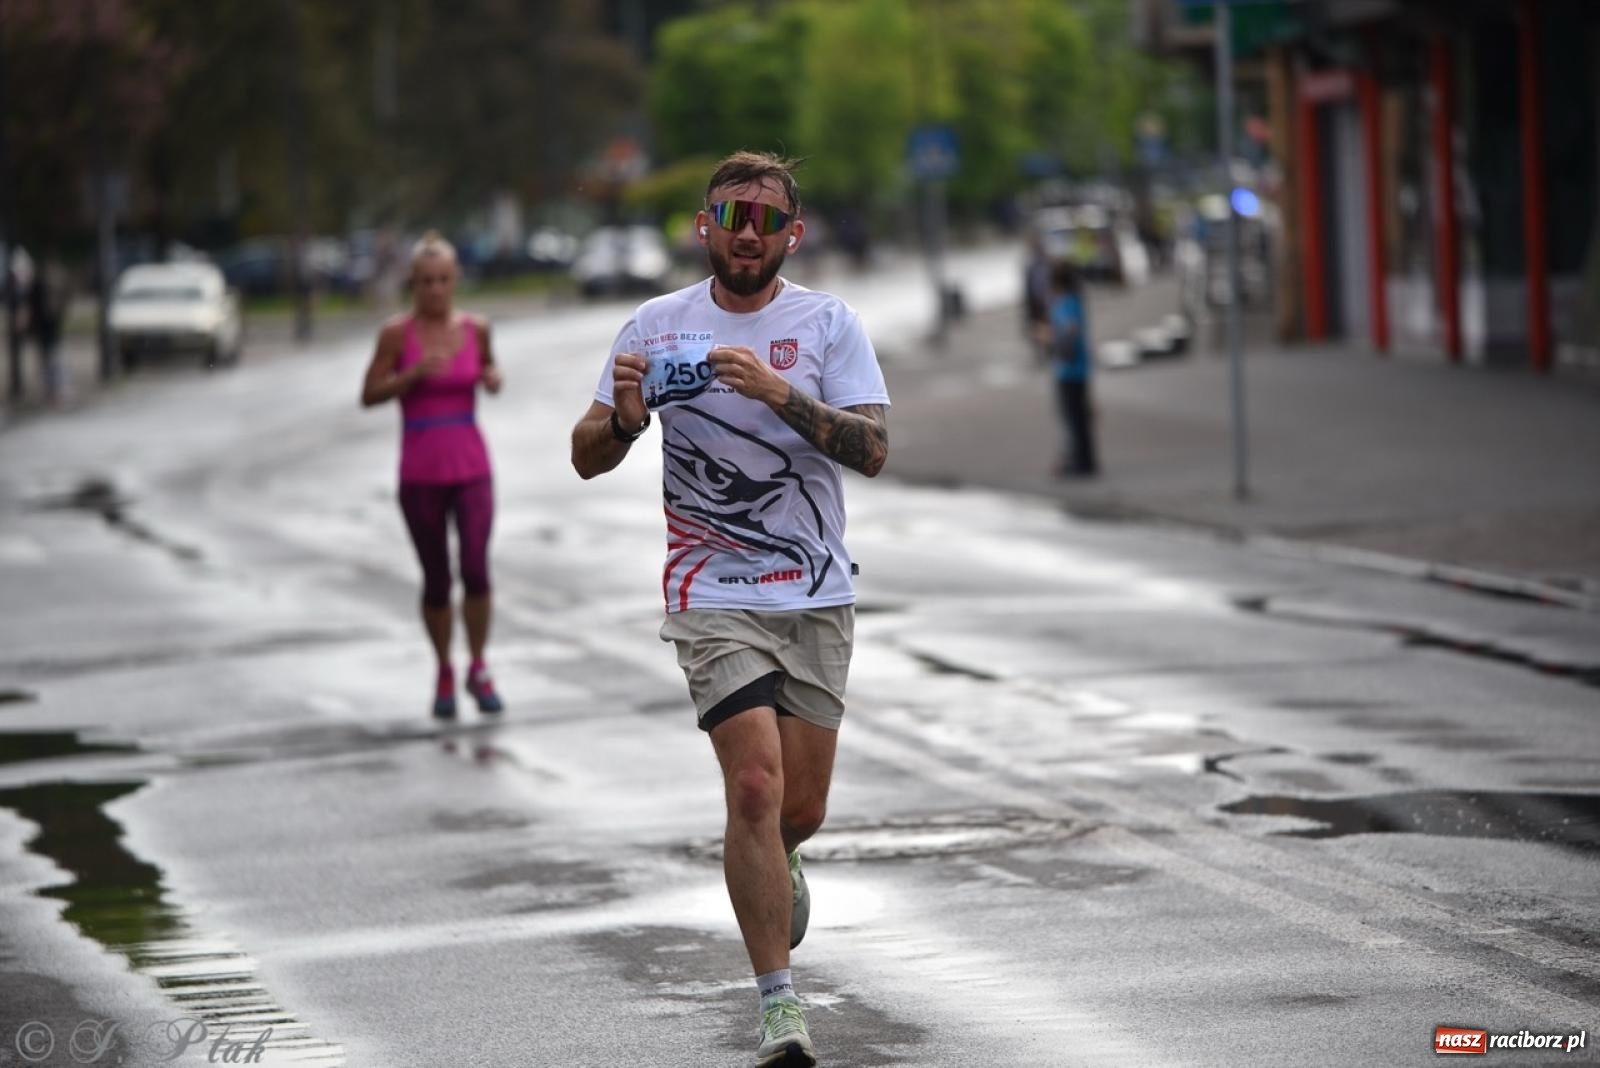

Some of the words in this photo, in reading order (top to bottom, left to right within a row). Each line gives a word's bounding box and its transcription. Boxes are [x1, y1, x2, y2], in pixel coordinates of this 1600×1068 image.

[659, 333, 679, 343] BIEG
[680, 333, 697, 341] BEZ
[664, 361, 712, 386] 250
